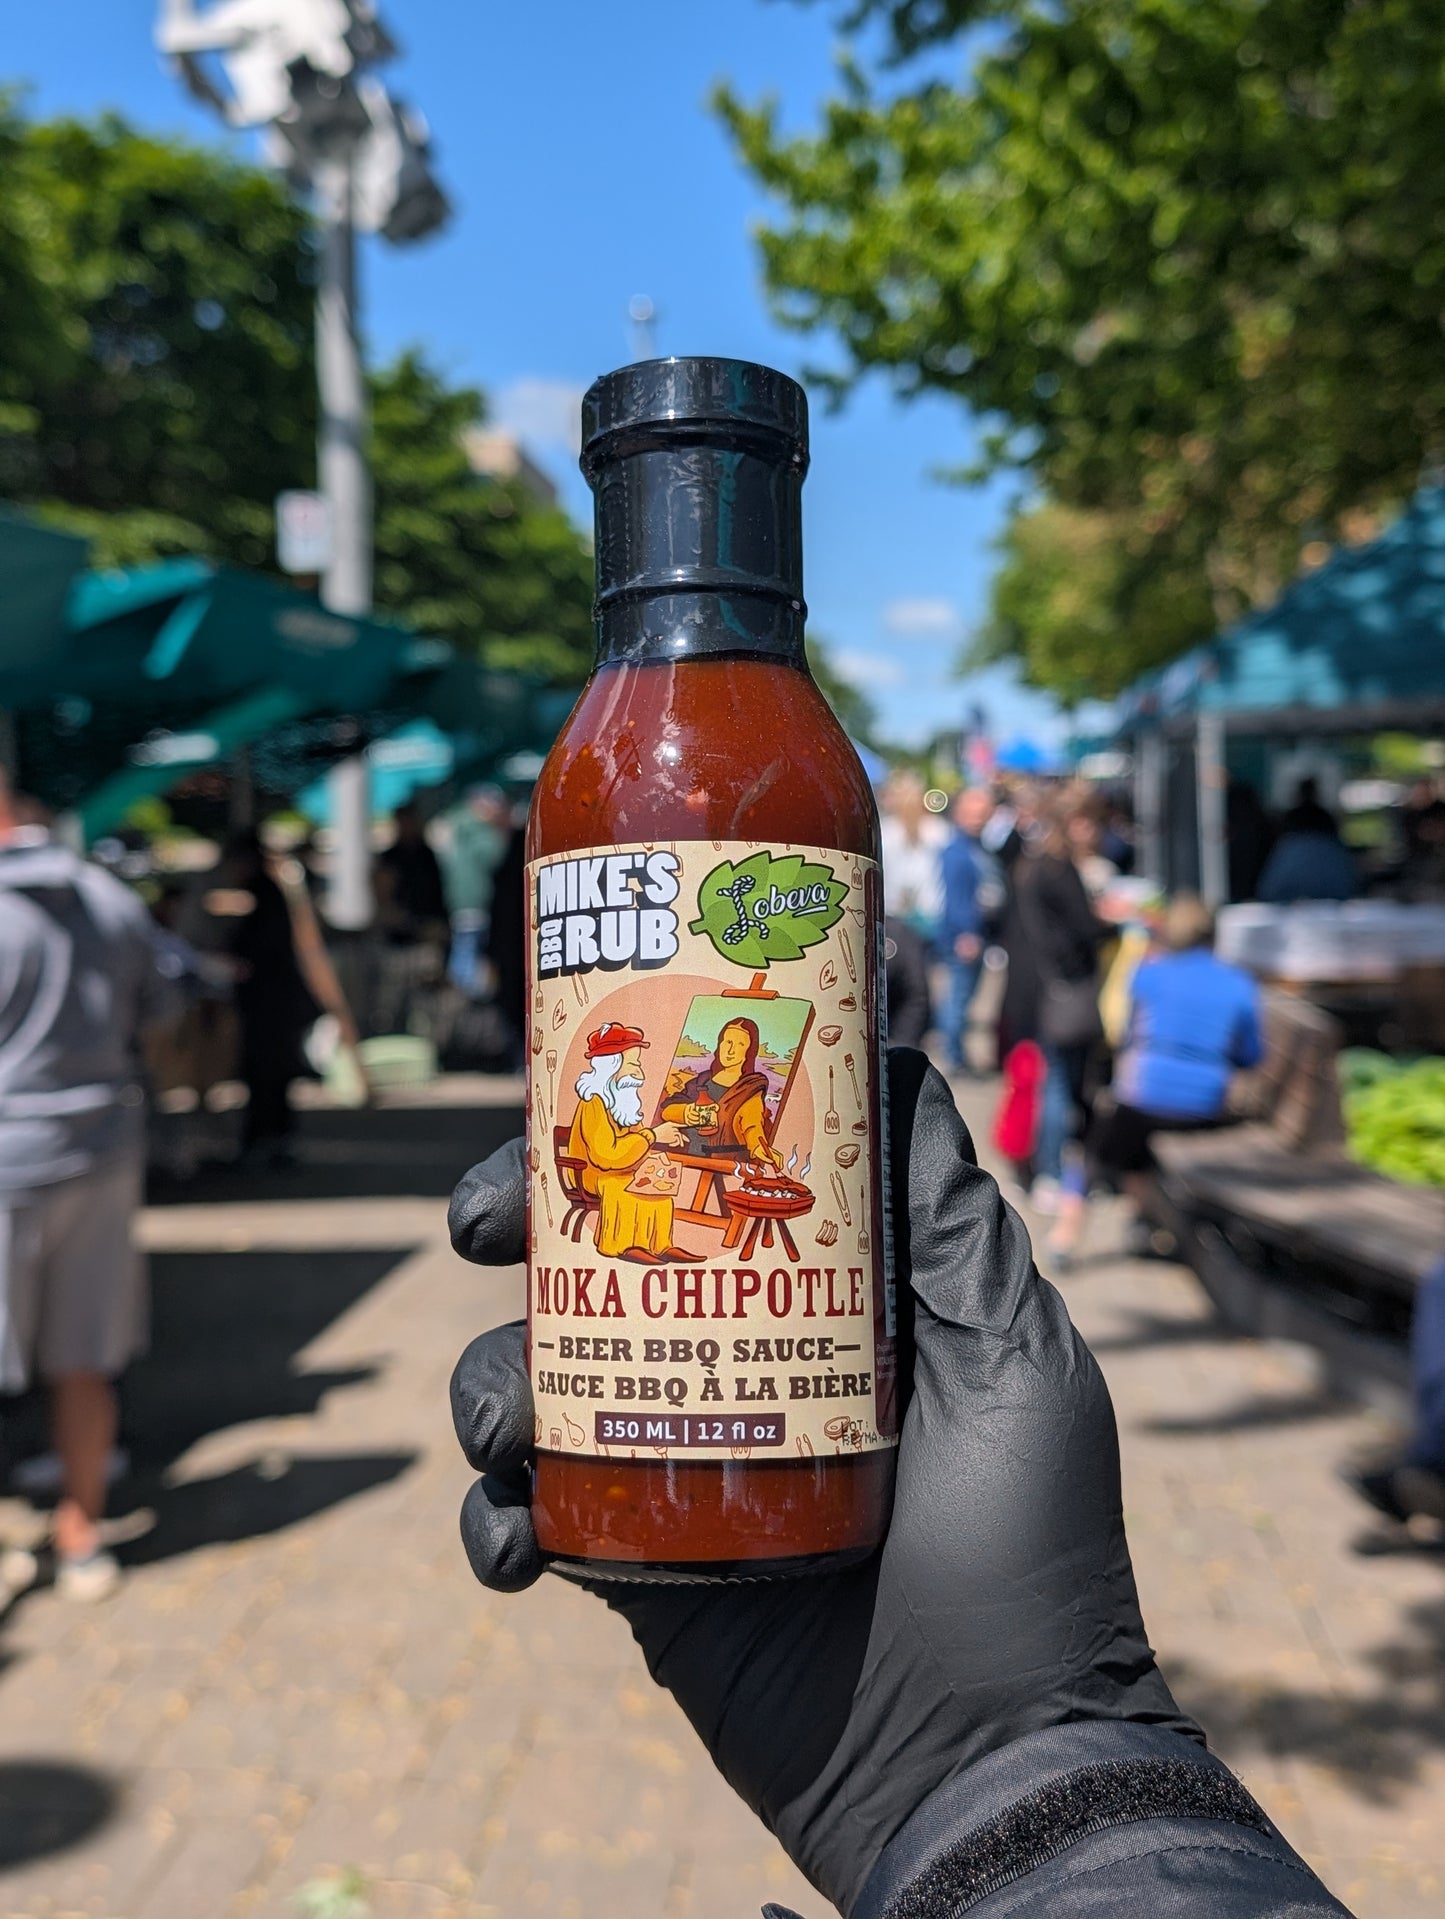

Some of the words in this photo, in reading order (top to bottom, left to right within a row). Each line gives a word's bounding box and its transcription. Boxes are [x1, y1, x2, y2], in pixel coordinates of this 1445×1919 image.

[540, 852, 679, 917] MIKE'S
[540, 918, 563, 971] BBQ
[565, 909, 678, 967] RUB
[537, 1267, 626, 1318] MOKA
[641, 1267, 864, 1318] CHIPOTLE
[559, 1336, 633, 1362] BEER
[643, 1338, 721, 1369] BBQ
[733, 1337, 833, 1363] SAUCE
[538, 1370, 604, 1399] SAUCE
[614, 1376, 688, 1408] BBQ
[700, 1369, 724, 1401] À
[735, 1377, 779, 1401] LA
[789, 1367, 871, 1400] BIÈRE
[603, 1420, 639, 1439] 350
[646, 1421, 676, 1440] ML
[698, 1422, 724, 1440] 12
[732, 1421, 746, 1440] fl
[753, 1425, 776, 1440] oz
